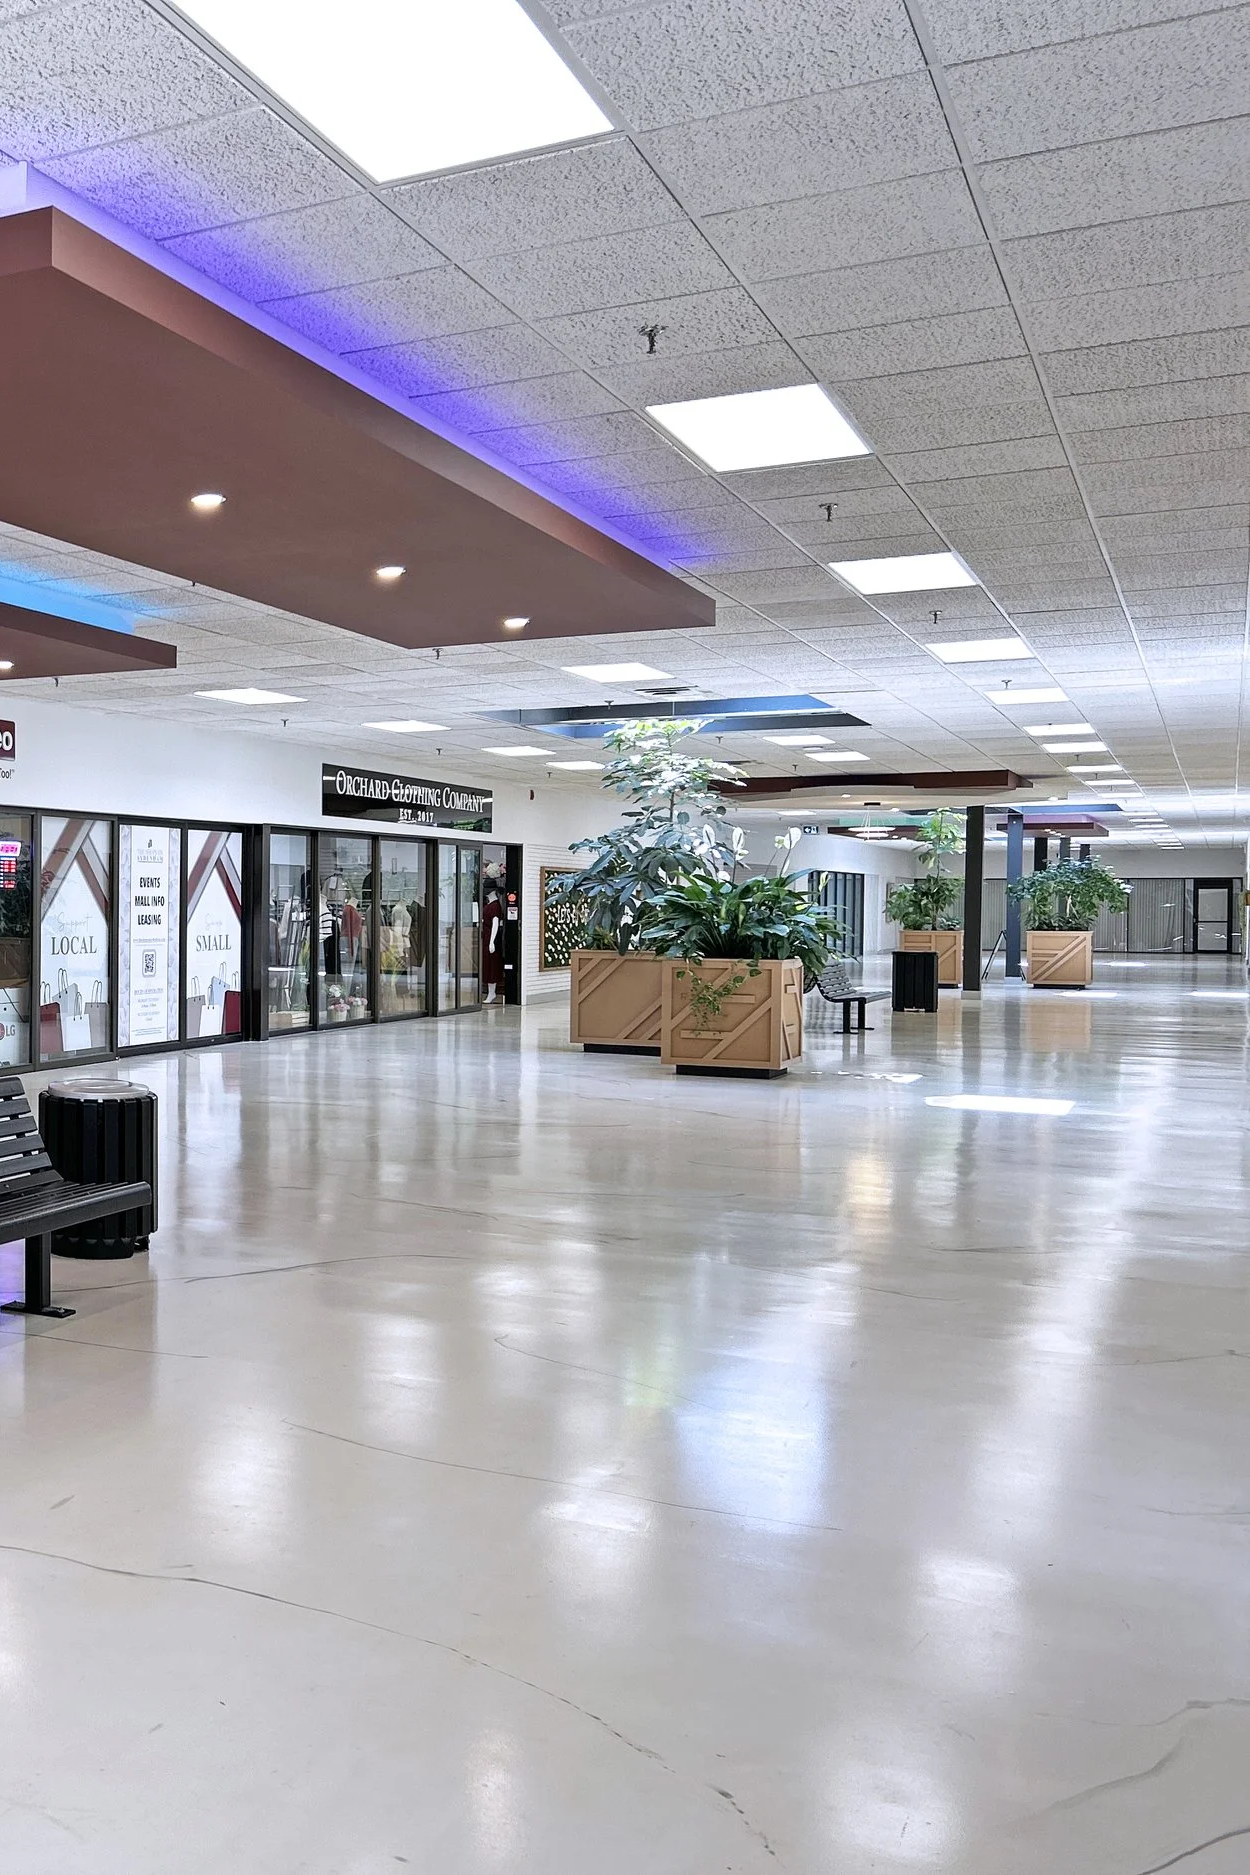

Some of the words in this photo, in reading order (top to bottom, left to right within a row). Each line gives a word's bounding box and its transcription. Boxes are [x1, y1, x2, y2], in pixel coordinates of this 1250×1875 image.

[335, 770, 390, 800] ORCHARD
[391, 779, 442, 807] CLOTHING
[442, 787, 485, 813] COMPANY
[417, 810, 434, 823] 2017
[139, 877, 161, 889] EVENTS
[134, 895, 150, 907] MALL
[151, 895, 165, 907] INFO
[137, 914, 162, 926] LEASING
[51, 935, 98, 955] LOCAL
[196, 934, 232, 952] SMALL
[5, 1024, 16, 1037] LG
